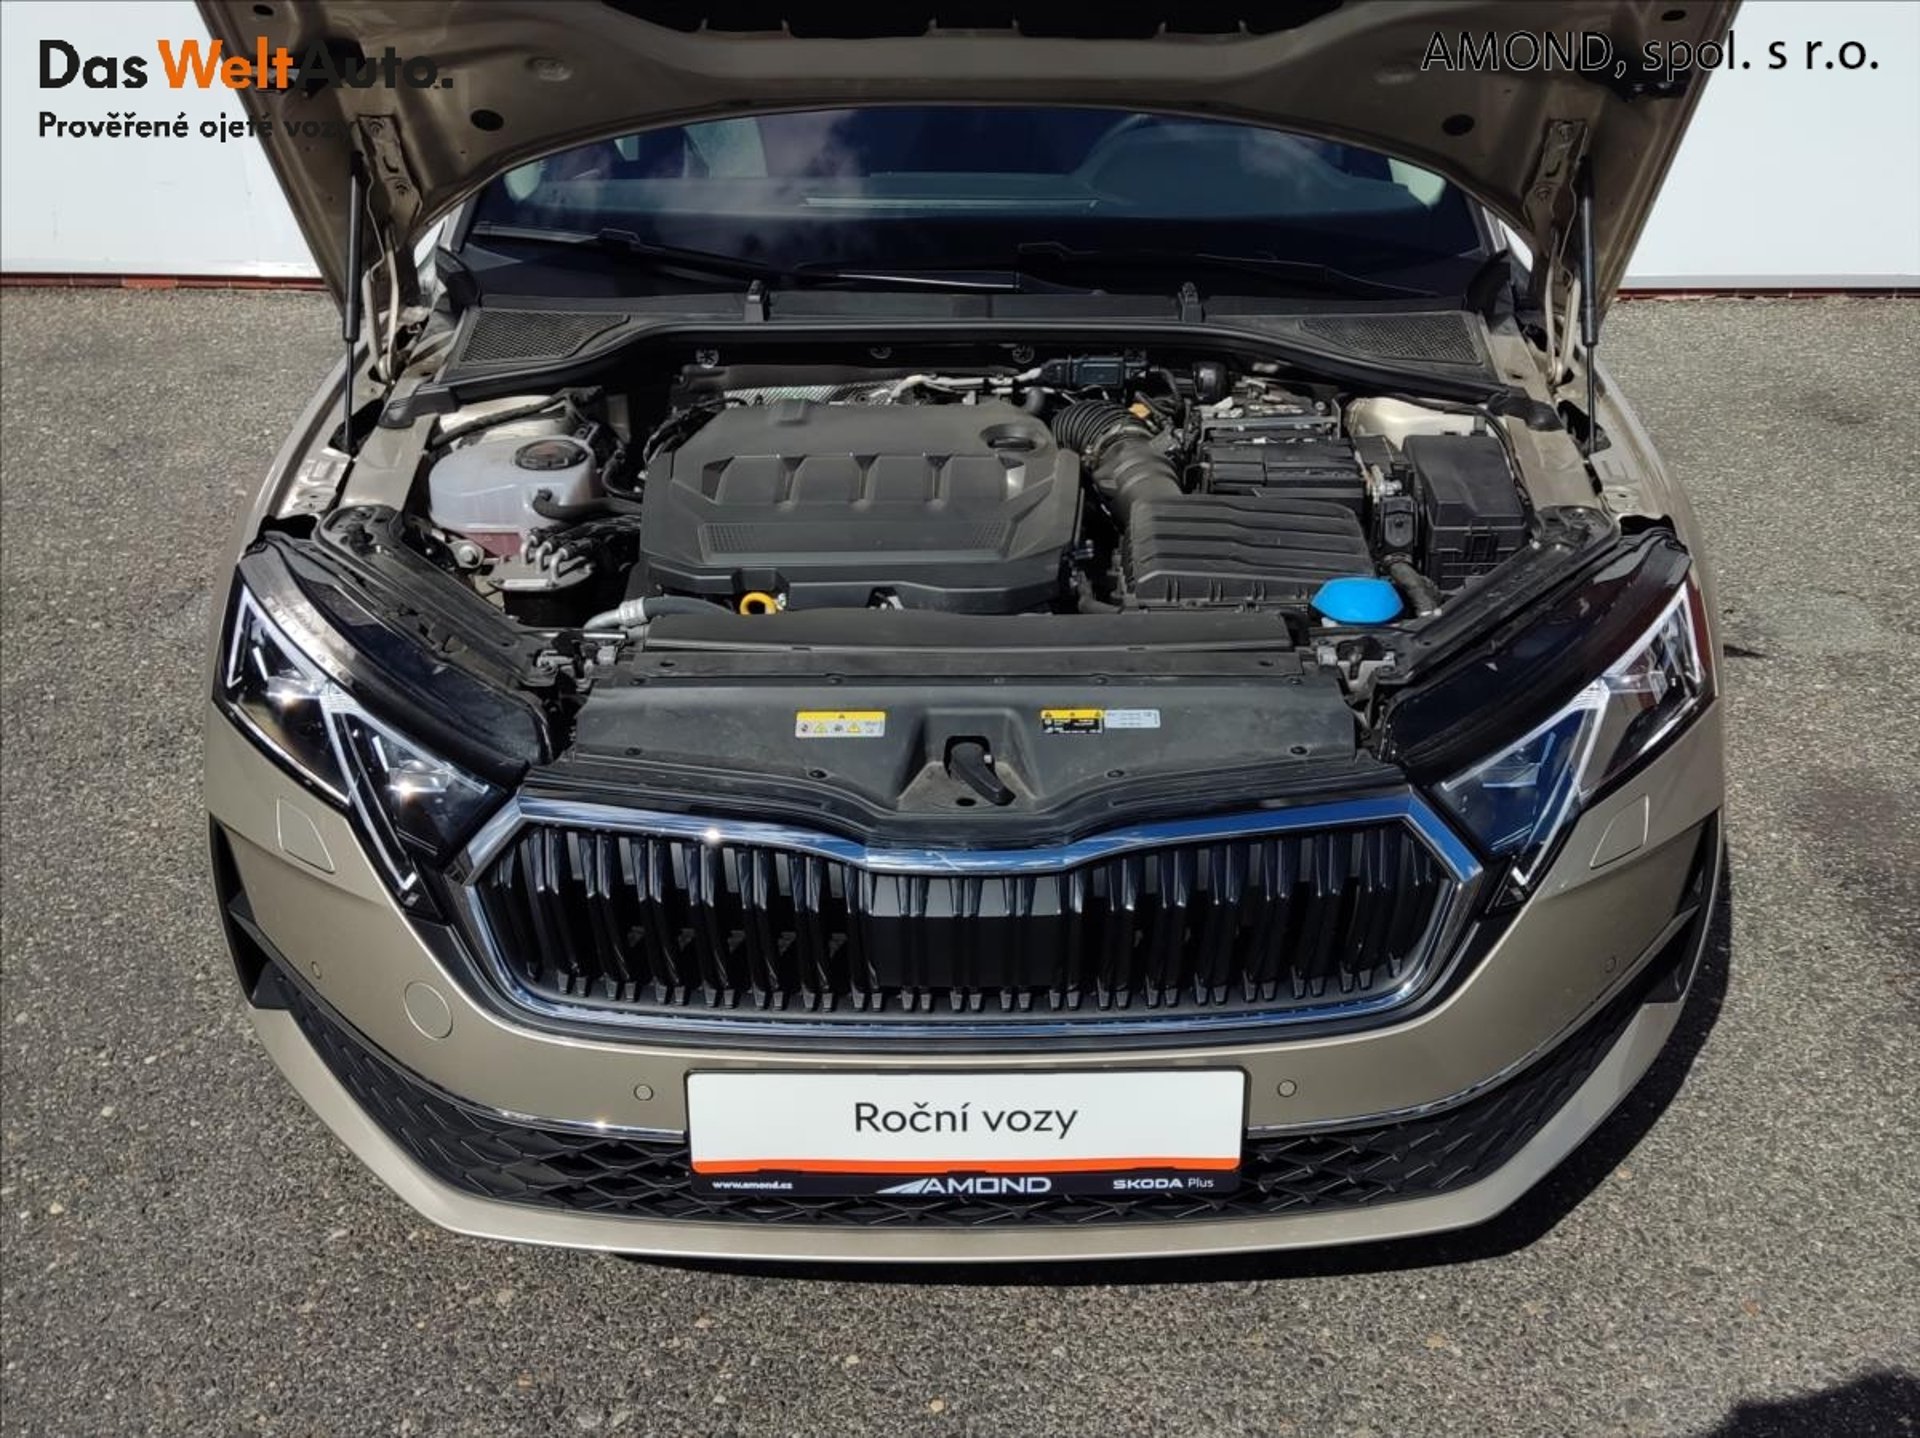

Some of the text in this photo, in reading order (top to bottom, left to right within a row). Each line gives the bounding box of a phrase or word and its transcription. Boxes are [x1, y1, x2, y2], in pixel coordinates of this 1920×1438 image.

[854, 1103, 1078, 1138] Roční vozy
[712, 1180, 793, 1190] www.amond.cz
[922, 1177, 1052, 1194] AMOND
[1188, 1177, 1214, 1188] Plus
